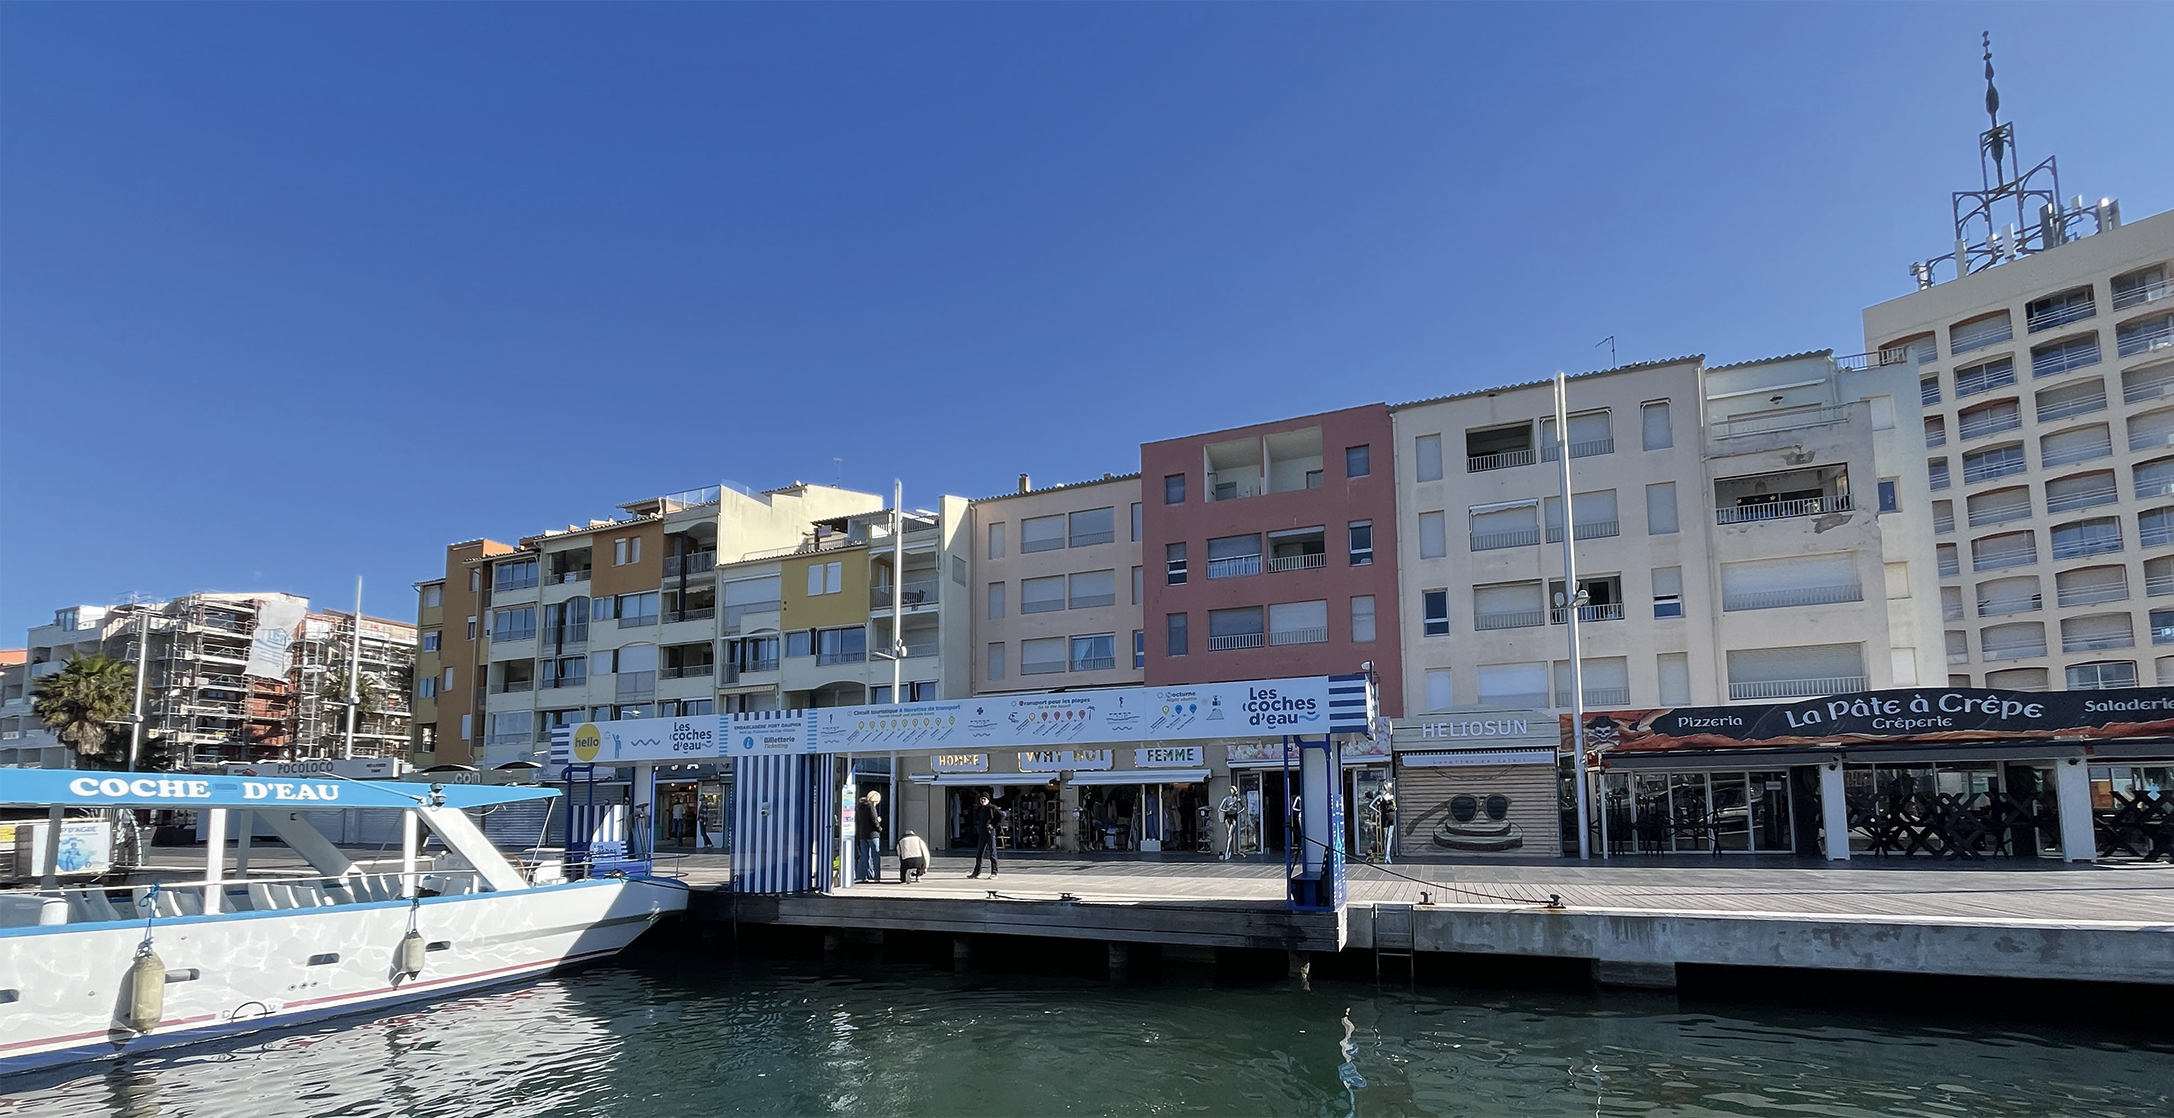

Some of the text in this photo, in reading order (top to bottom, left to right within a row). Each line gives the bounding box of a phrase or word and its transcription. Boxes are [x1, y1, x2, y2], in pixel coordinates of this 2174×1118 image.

[1250, 687, 1277, 700] Les
[1247, 696, 1317, 712] coches
[1785, 693, 2044, 728] La Pâte à Crêpe
[674, 722, 690, 732] Les
[1678, 715, 1742, 728] Pizzeria
[1872, 715, 1953, 730] Crêperie
[672, 728, 712, 741] coches
[1422, 719, 1528, 738] HELIOSUN
[574, 736, 599, 748] hello
[938, 755, 979, 767] HOMME
[1026, 750, 1105, 763] WHY NOT
[1147, 748, 1194, 762] FEMME
[277, 761, 334, 774] POCOLOCO
[450, 772, 481, 784] .com
[69, 777, 340, 801] COCHE D'EAU
